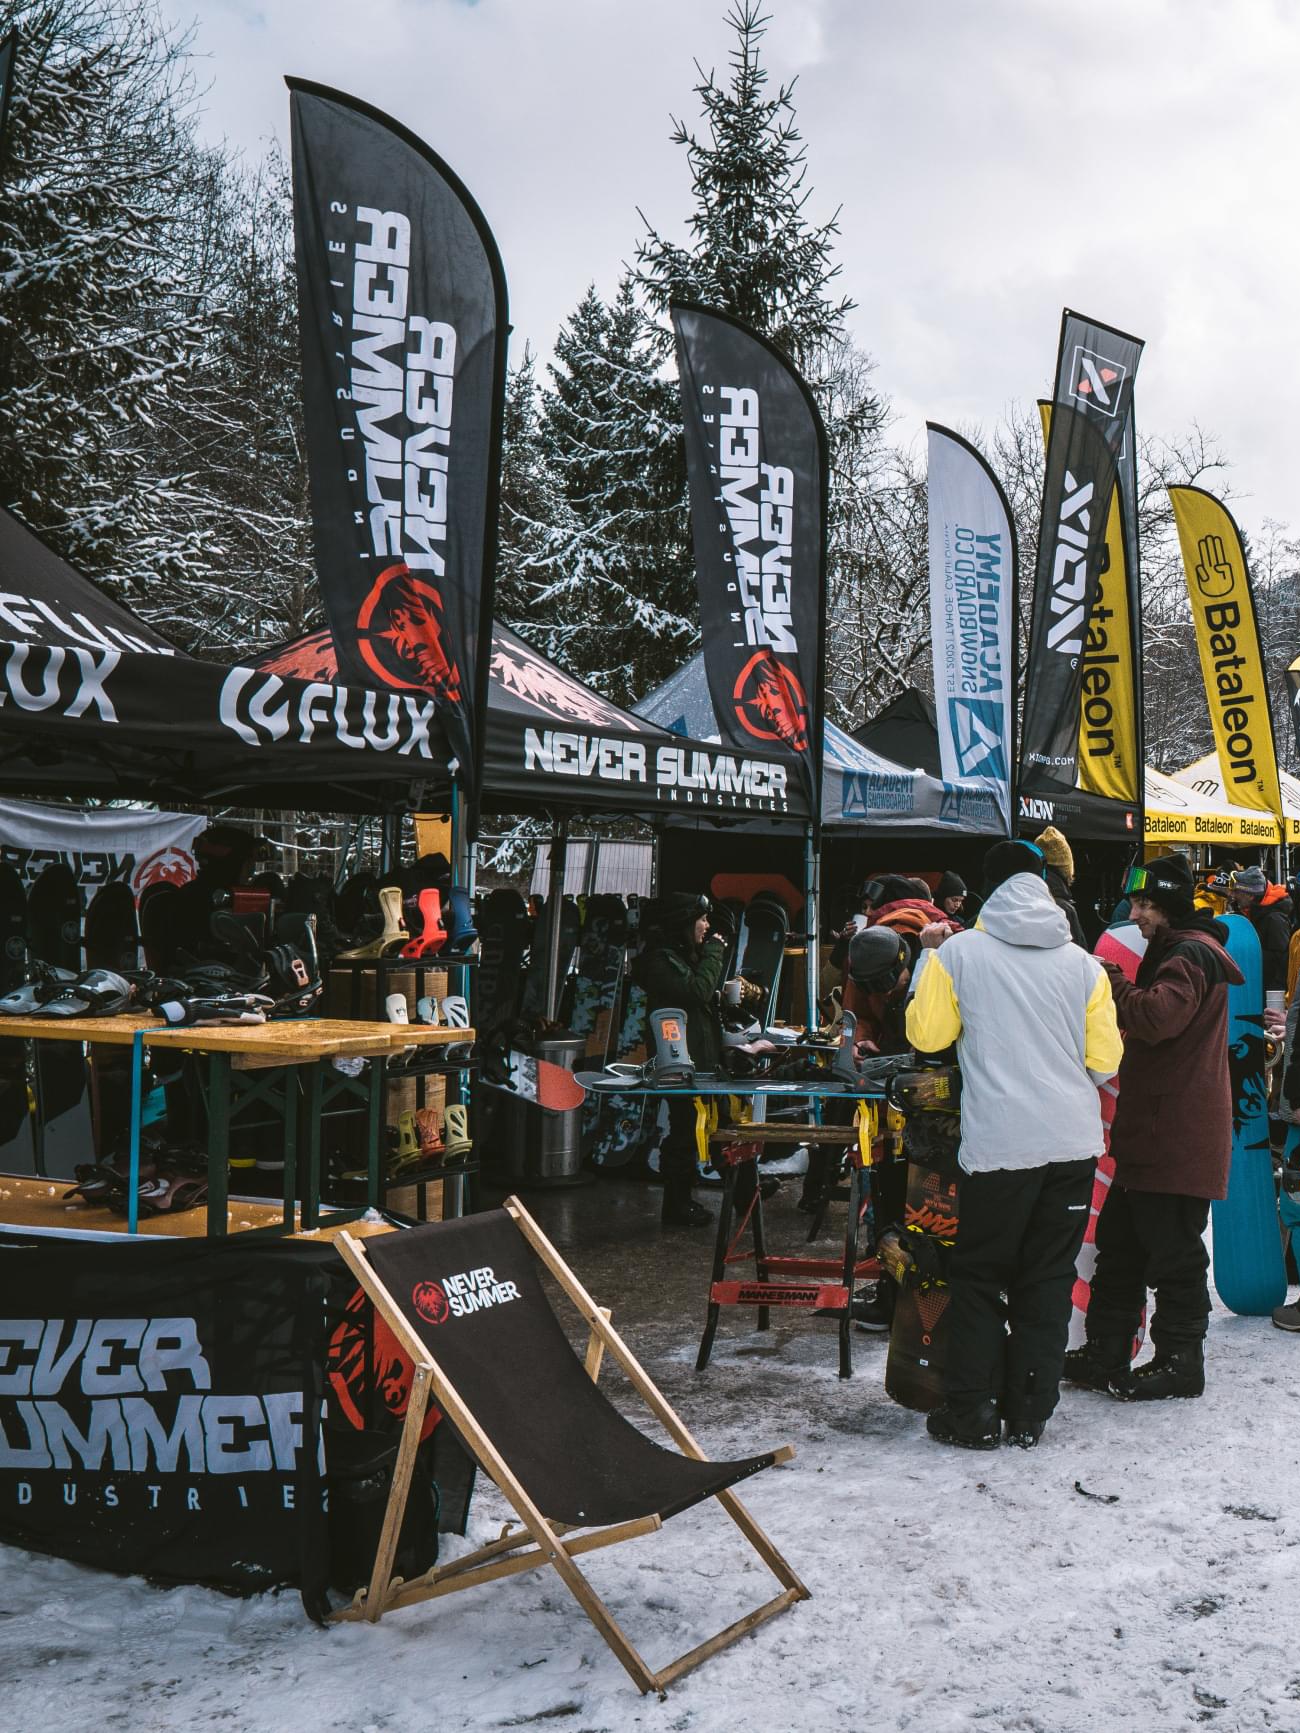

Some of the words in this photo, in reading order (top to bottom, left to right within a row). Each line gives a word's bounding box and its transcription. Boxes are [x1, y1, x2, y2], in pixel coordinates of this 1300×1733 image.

[1047, 469, 1095, 655] XION
[0, 641, 121, 723] UX
[1205, 601, 1258, 784] Bataleon
[299, 682, 435, 759] FLUX
[524, 727, 647, 782] NEVER
[656, 746, 788, 799] SUMMER
[656, 788, 789, 812] INDUSTRIES
[1019, 796, 1054, 821] XION
[1144, 817, 1187, 833] Bataleon
[1195, 817, 1233, 834] Bataleon
[1240, 819, 1275, 838] Bataleon
[442, 1266, 499, 1297] NEVER
[448, 1280, 522, 1317] SUMMER
[0, 1317, 212, 1396] EVER
